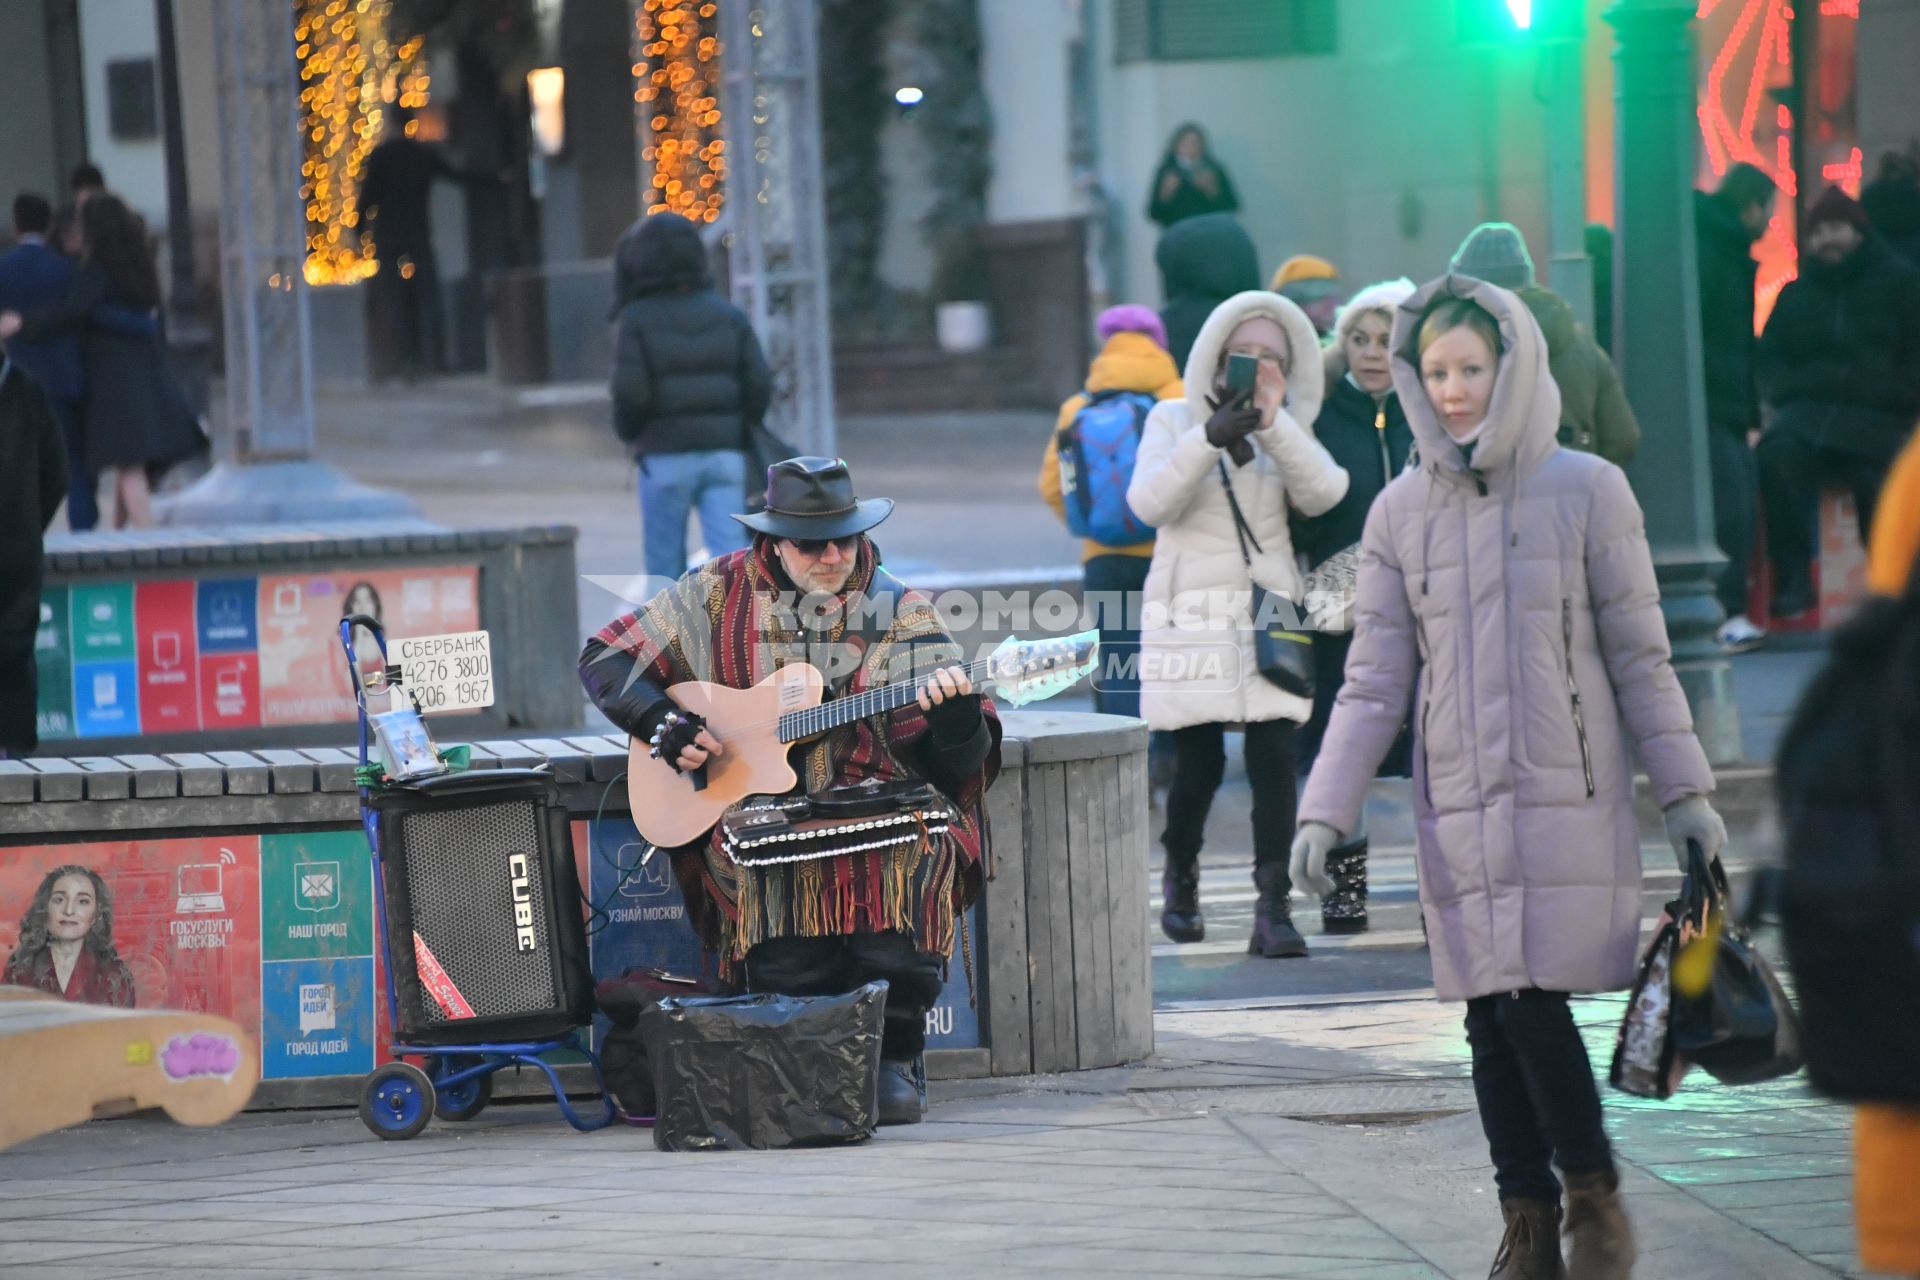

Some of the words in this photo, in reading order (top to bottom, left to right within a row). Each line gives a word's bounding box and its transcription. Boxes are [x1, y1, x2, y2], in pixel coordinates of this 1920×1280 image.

[402, 635, 486, 658] СБЕРБАНК
[405, 659, 447, 683] 4276
[454, 655, 489, 679] 3800
[455, 680, 489, 704] 1967
[509, 853, 536, 951] CUBE
[608, 906, 641, 923] УЗНАЙ
[643, 905, 685, 921] МОСКВУ
[170, 919, 233, 936] ГОСУСЛУГИ
[288, 924, 313, 939] НАШ
[314, 922, 348, 938] ГОРОД
[178, 933, 226, 950] МОСКВЫ
[303, 987, 331, 999] ГОРОД
[303, 1000, 328, 1013] ИДЕЙ
[923, 1006, 953, 1036] .RU
[286, 1041, 319, 1056] ГОРОД
[320, 1037, 349, 1055] ИДЕЙ
